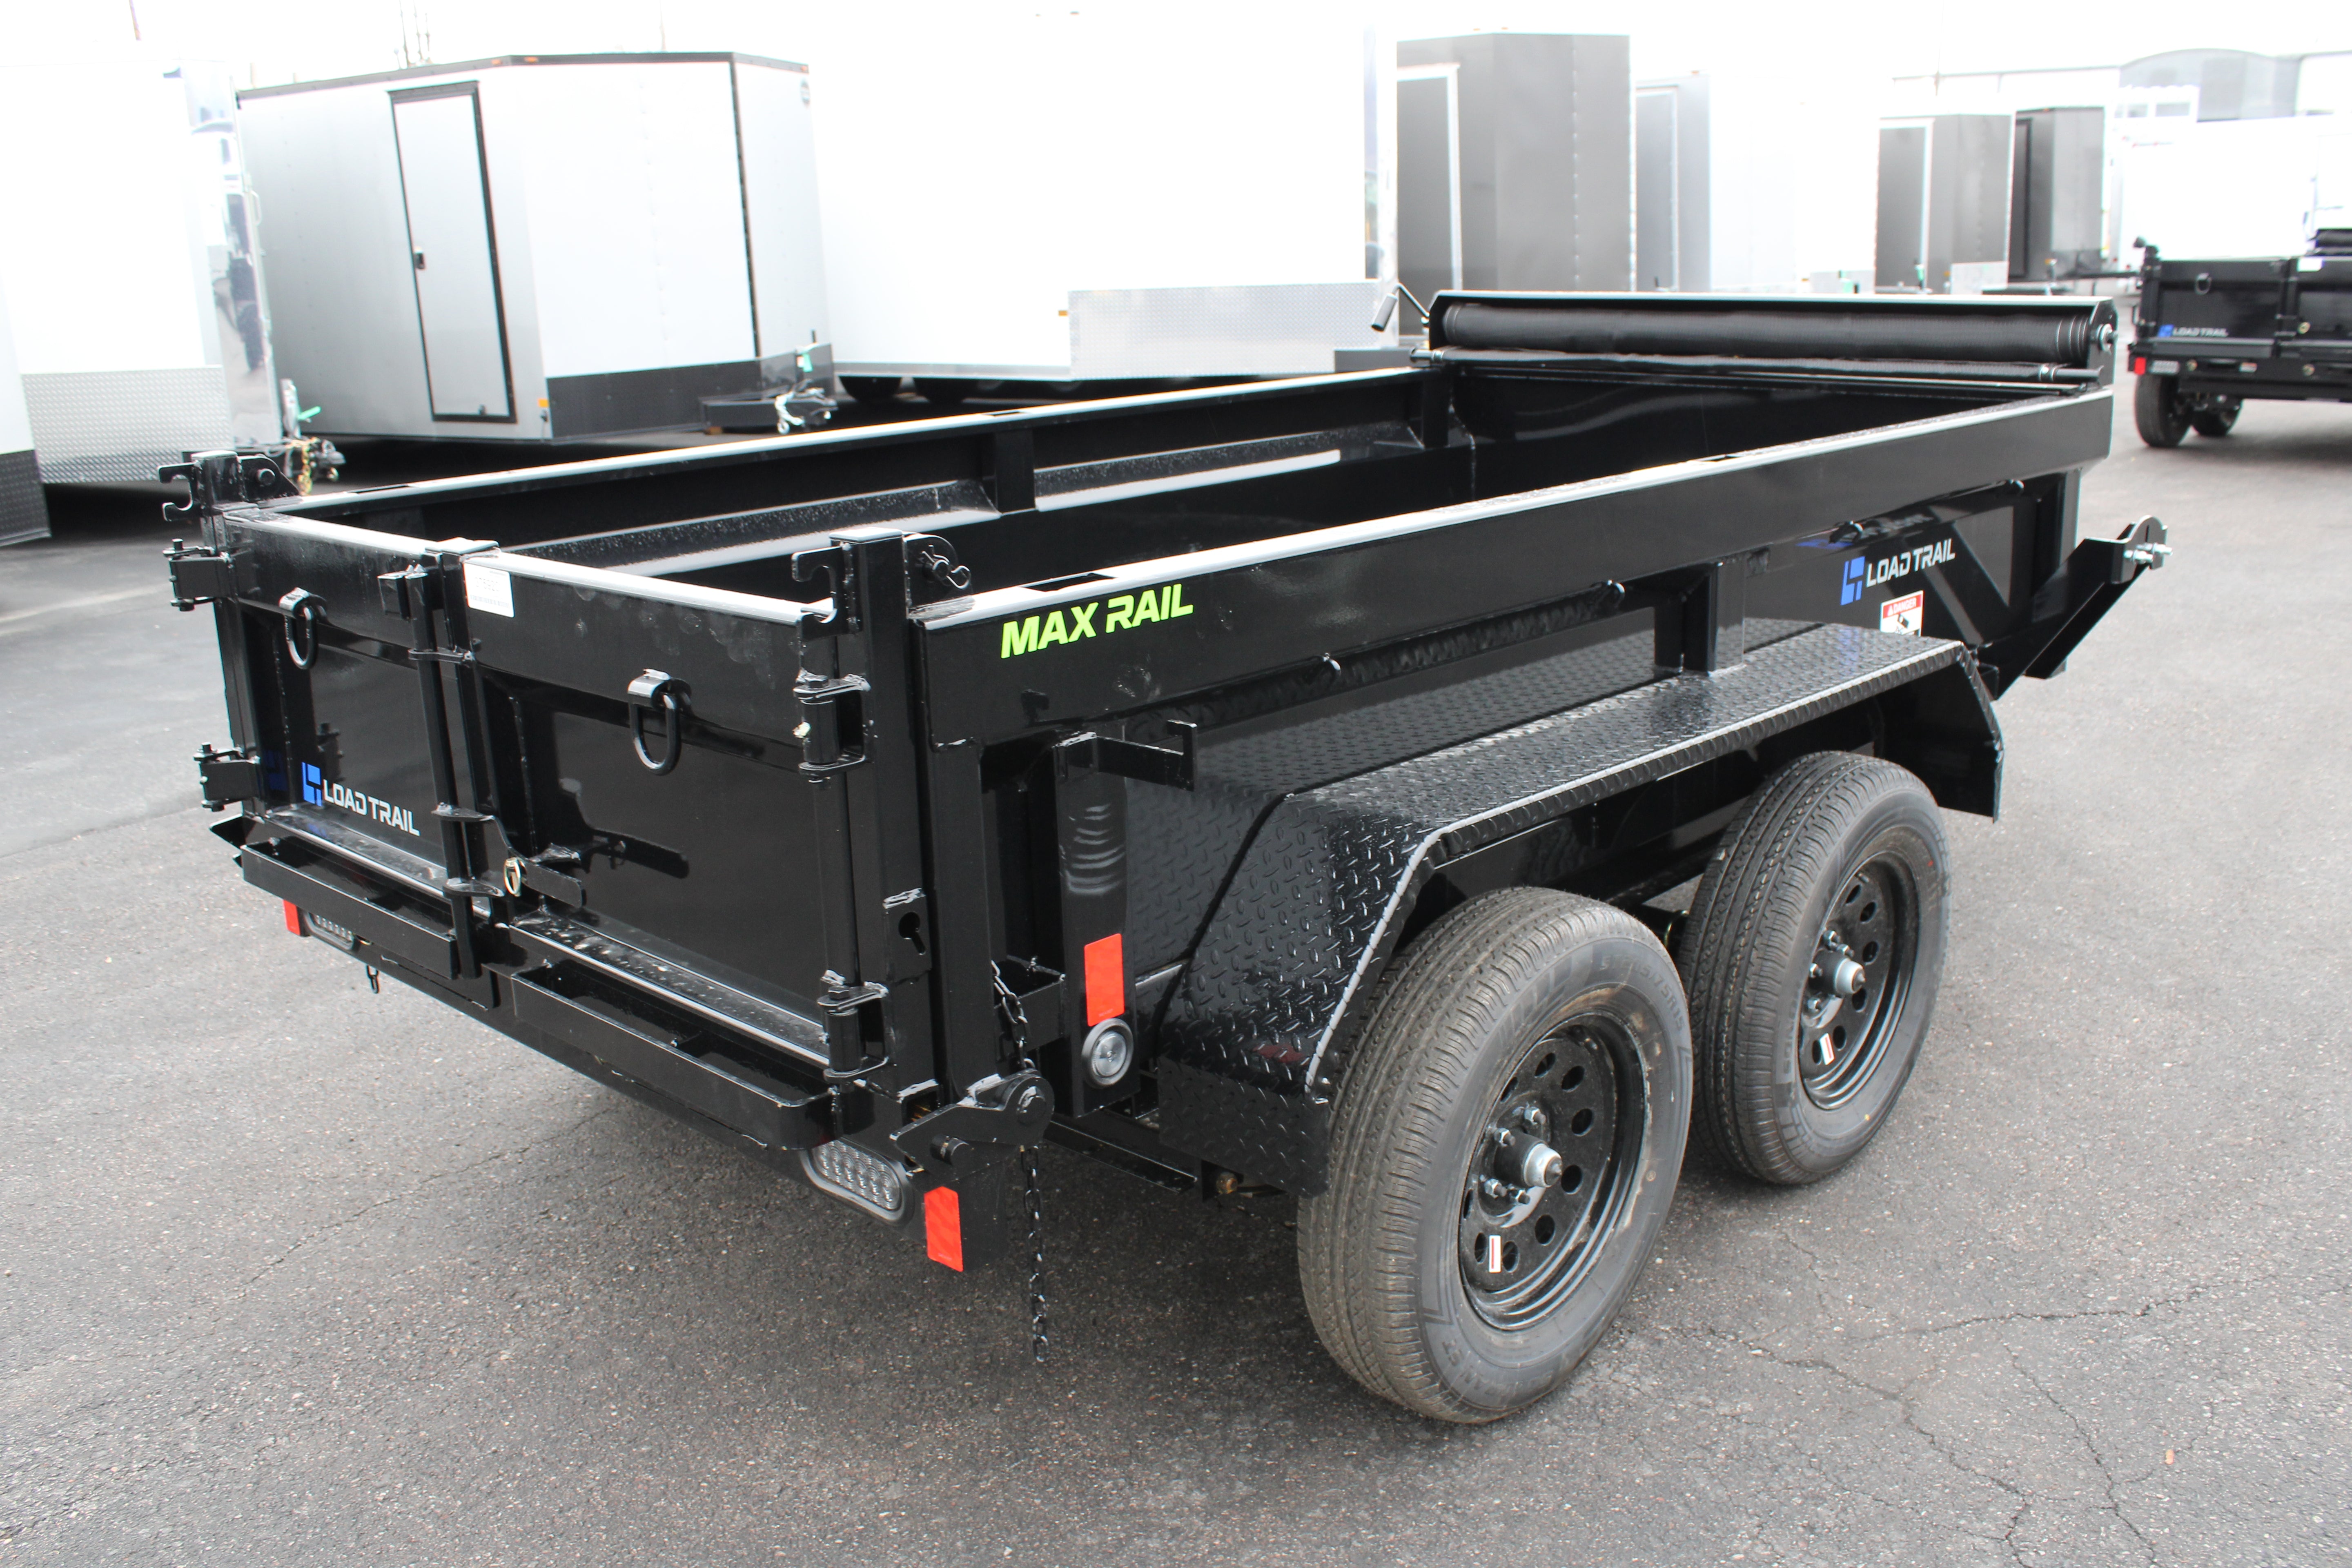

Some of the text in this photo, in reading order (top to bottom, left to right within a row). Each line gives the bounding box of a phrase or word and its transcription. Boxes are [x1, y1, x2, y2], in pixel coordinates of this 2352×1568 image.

[1000, 583, 1194, 659] MAX RAIL
[1893, 597, 1917, 613] DANGER
